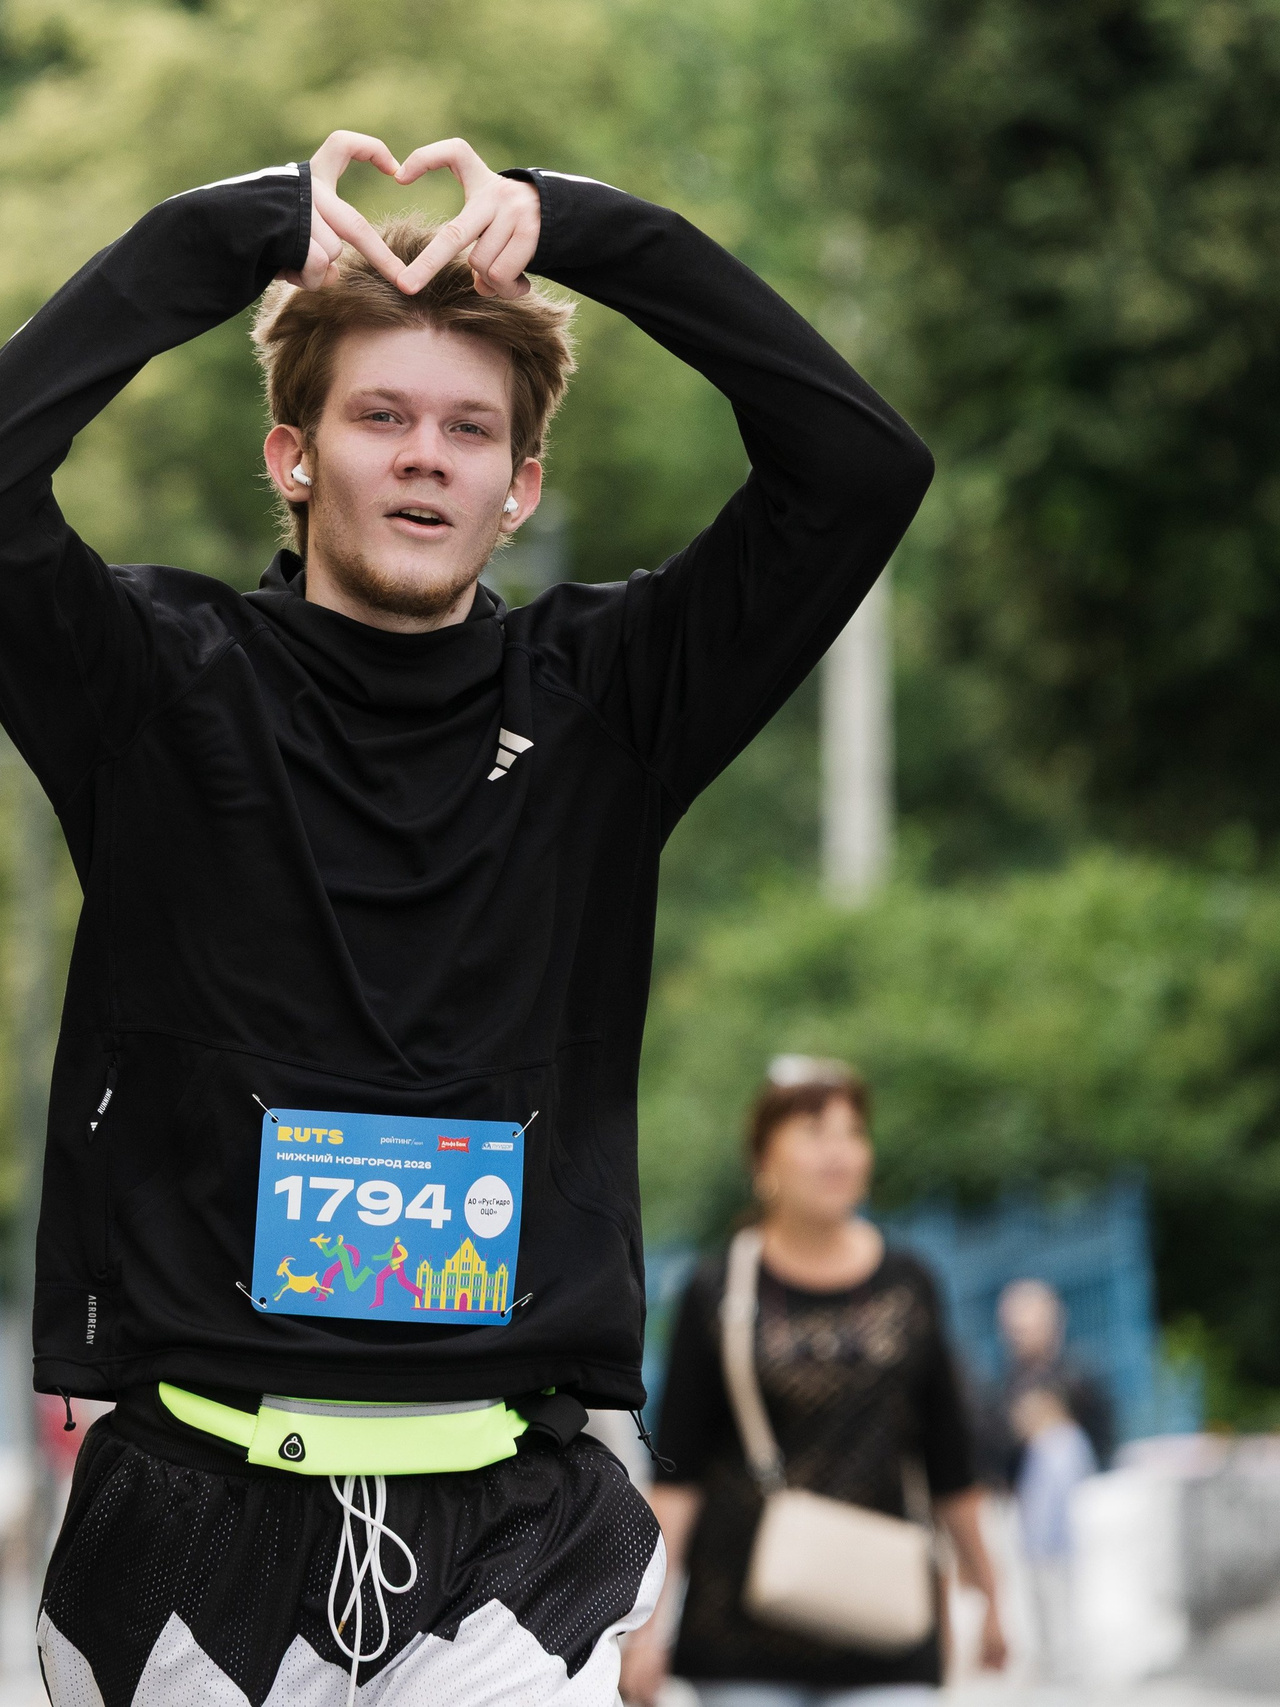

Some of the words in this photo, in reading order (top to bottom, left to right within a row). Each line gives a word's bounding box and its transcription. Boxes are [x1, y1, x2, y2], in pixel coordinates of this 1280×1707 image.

[97, 1087, 113, 1115] RUNNING
[277, 1125, 344, 1145] RUTS
[276, 1152, 333, 1164] НИЖНИЙ
[335, 1156, 402, 1169] НОВГОРОД
[403, 1160, 432, 1170] 2026
[274, 1175, 452, 1229] 1794
[86, 1294, 97, 1345] AEROREADY
